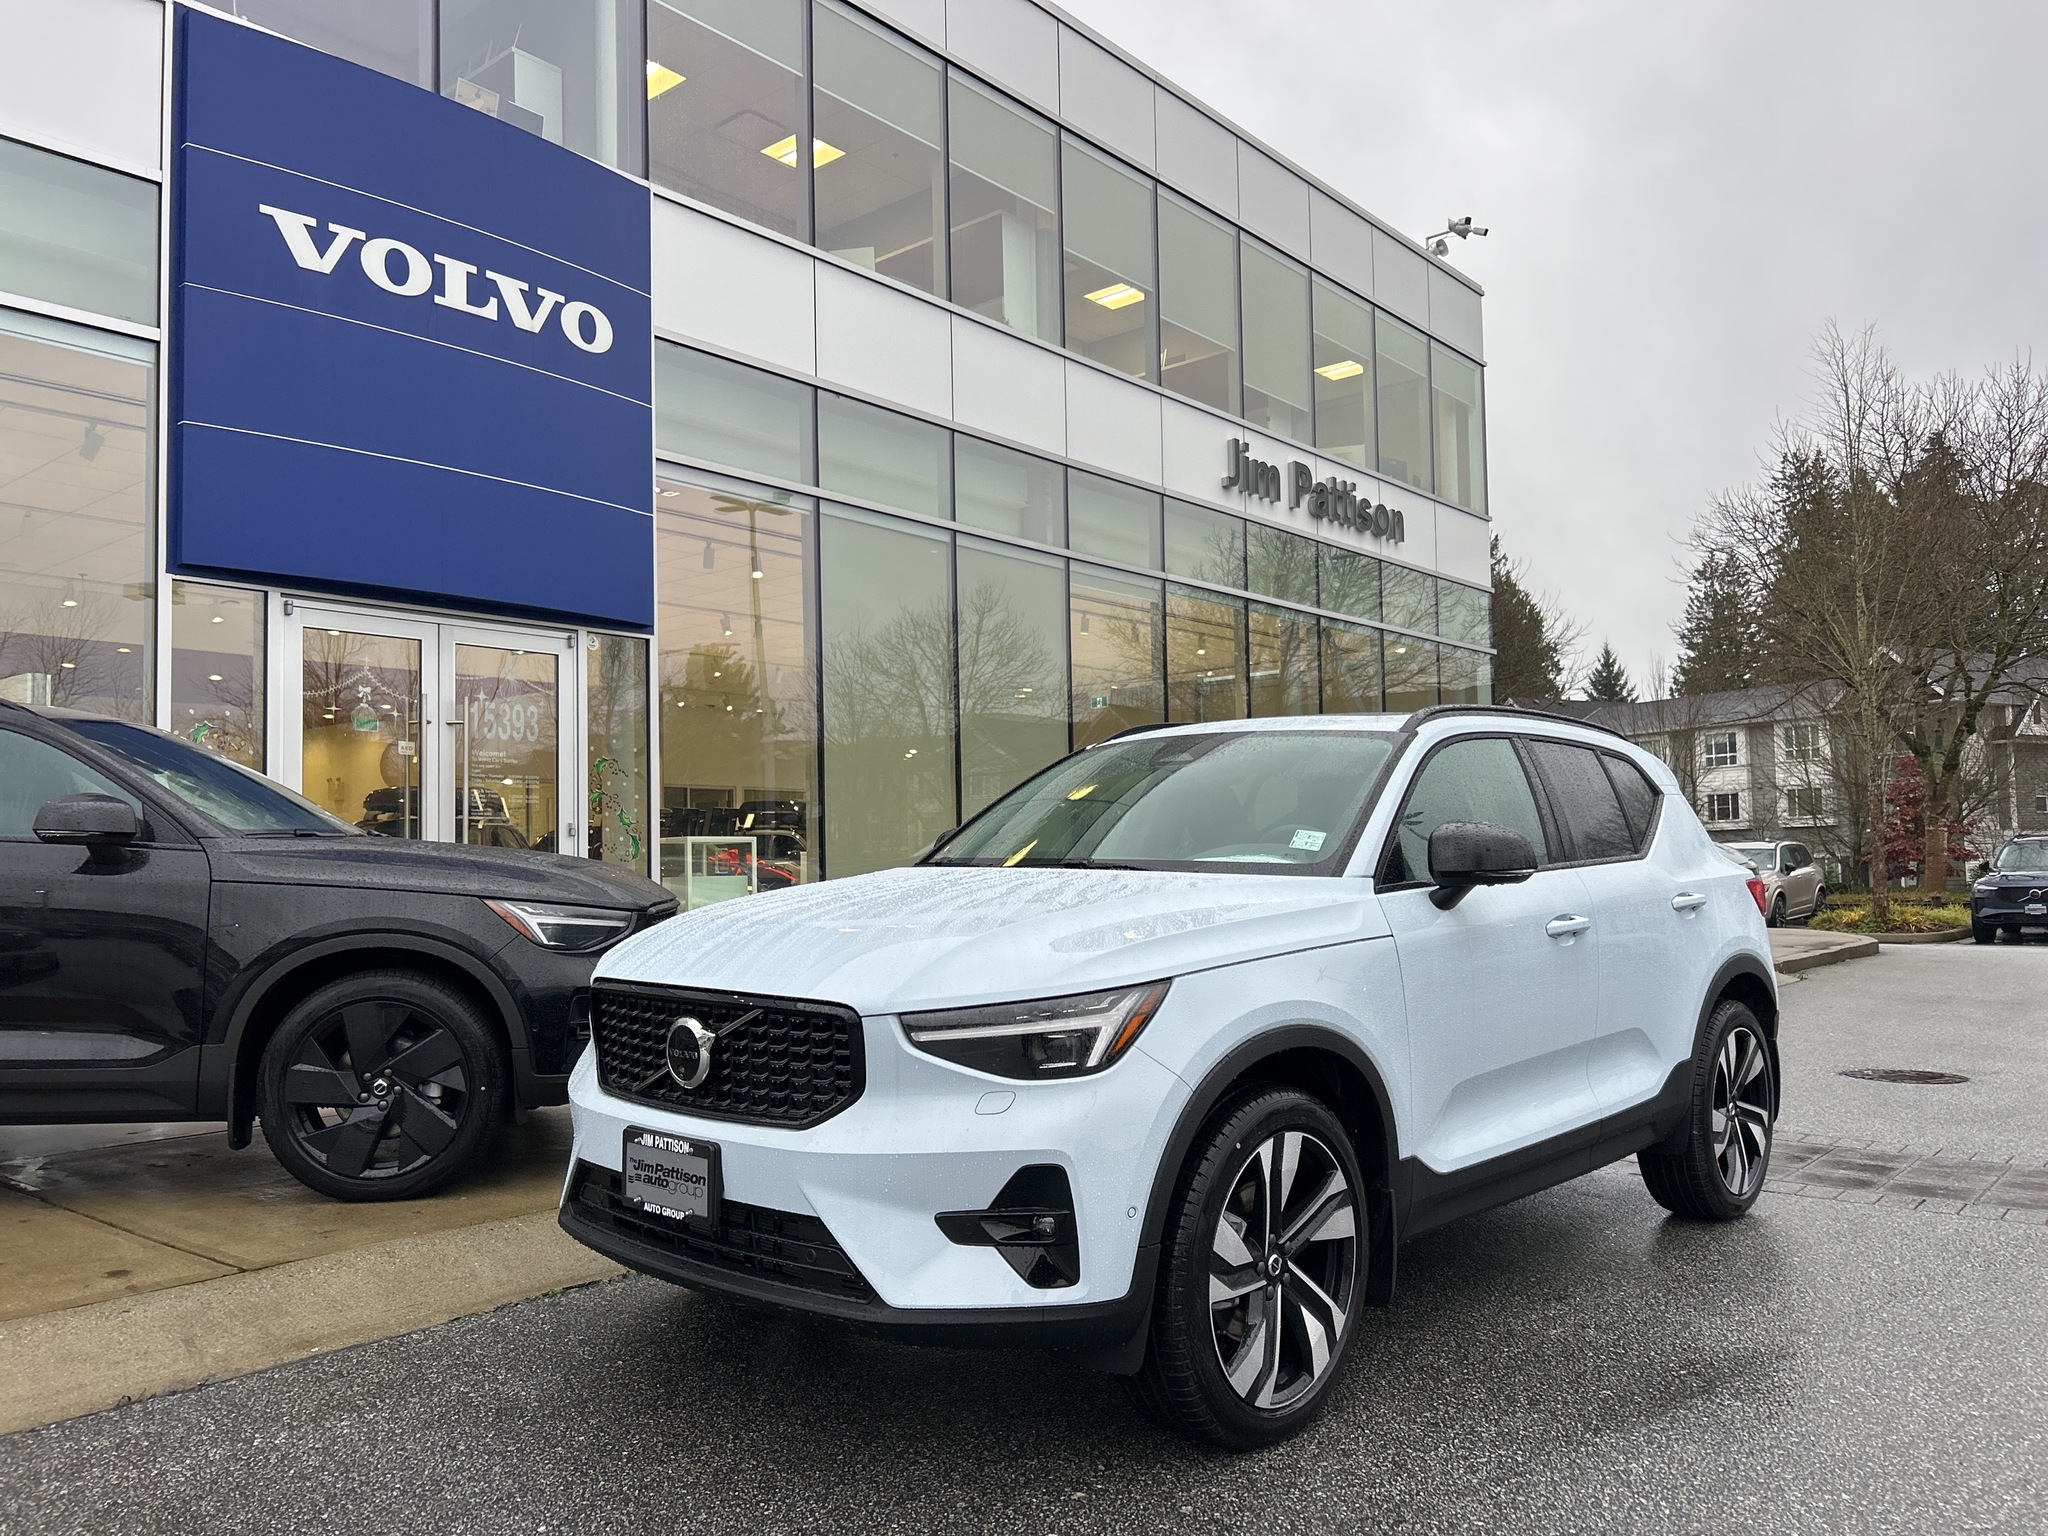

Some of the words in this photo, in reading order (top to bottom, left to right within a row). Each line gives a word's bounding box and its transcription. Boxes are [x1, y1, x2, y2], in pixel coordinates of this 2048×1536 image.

[259, 203, 613, 353] VOLVO
[1221, 437, 1281, 503] Jim
[1288, 460, 1405, 544] Pattison
[470, 701, 539, 742] 15393
[472, 749, 506, 758] Welcome!
[669, 1048, 699, 1060] VOLVO
[641, 1133, 654, 1147] JIM
[654, 1136, 690, 1154] PATTISON
[643, 1202, 661, 1215] AUTO
[661, 1206, 685, 1220] GROUP
